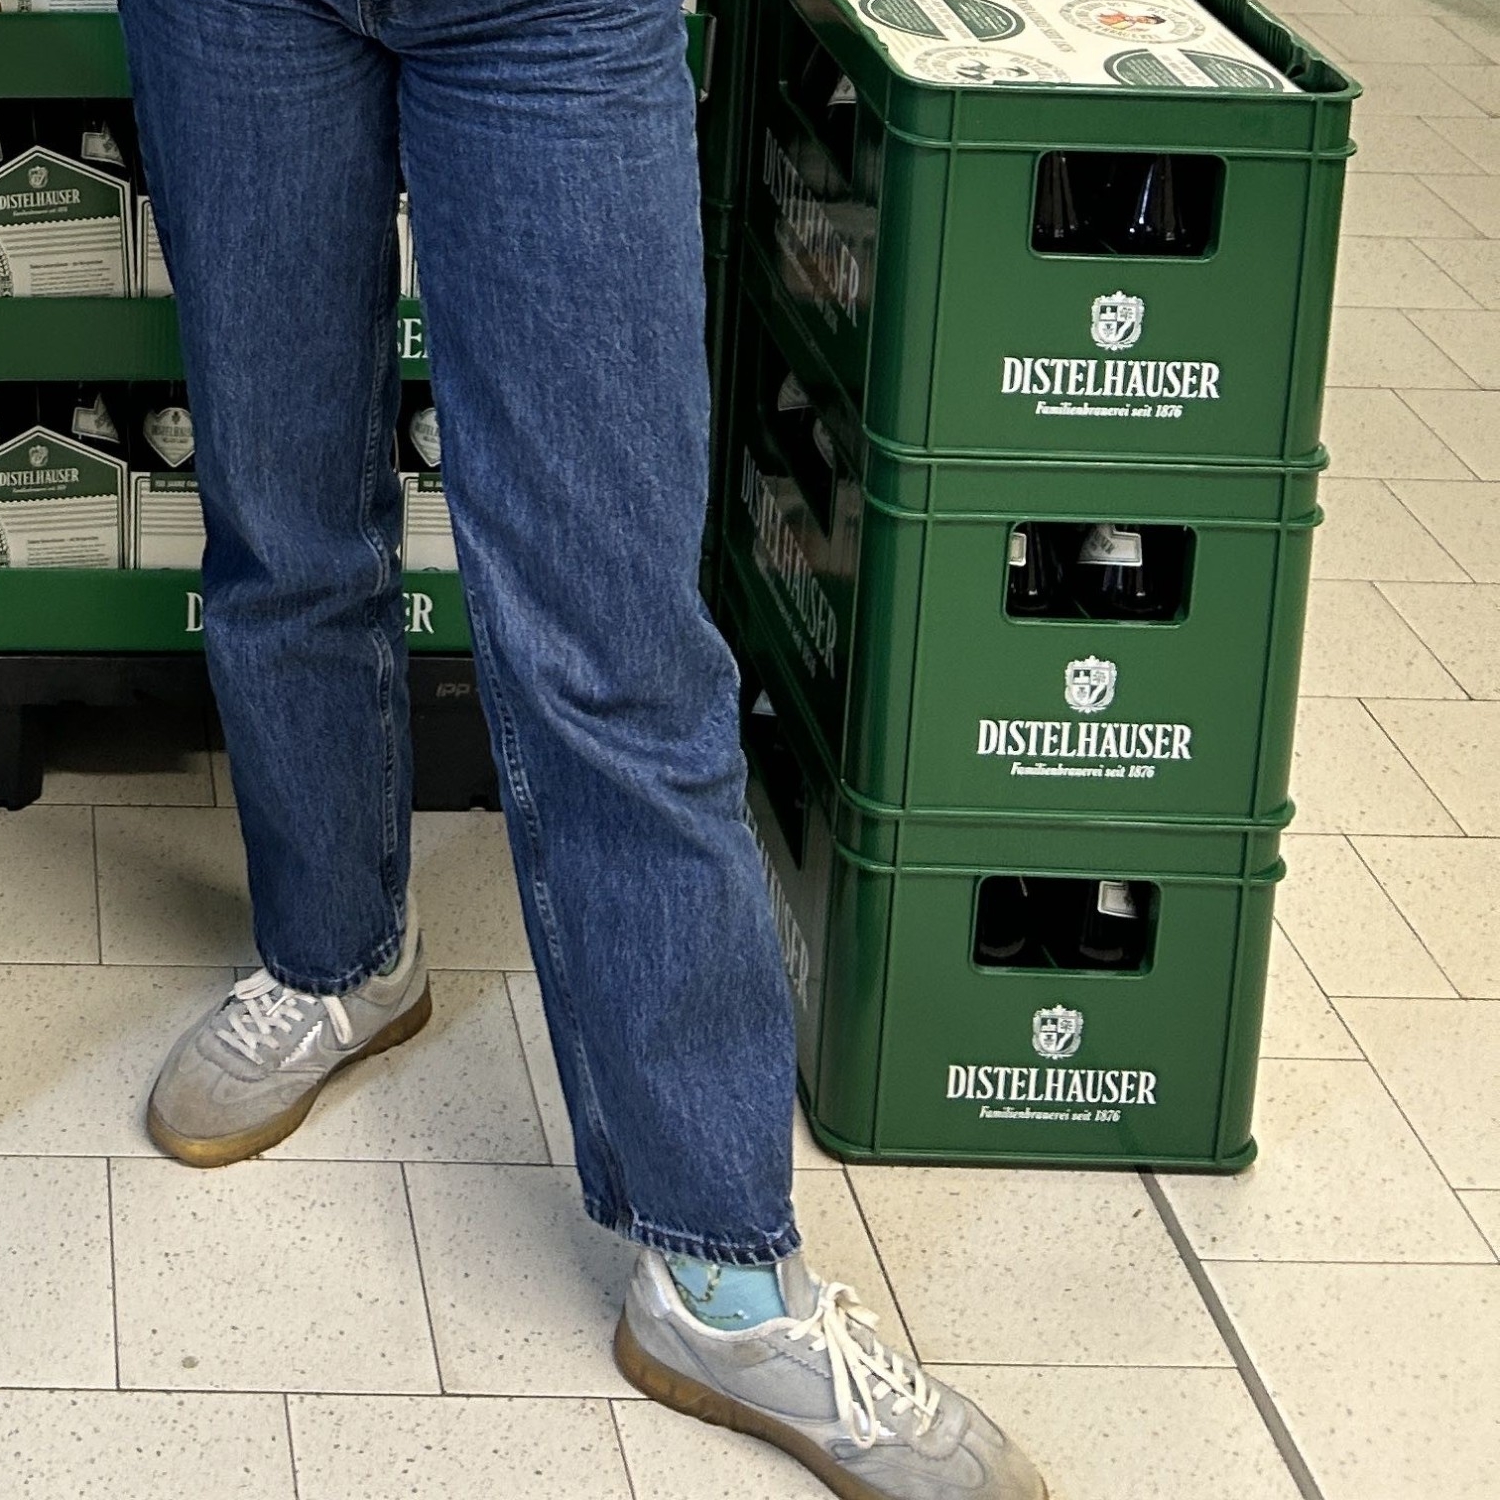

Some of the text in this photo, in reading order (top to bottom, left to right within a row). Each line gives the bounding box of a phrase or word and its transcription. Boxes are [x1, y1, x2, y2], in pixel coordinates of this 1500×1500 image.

[1001, 357, 1220, 399] DISTELHÄUSER
[1035, 401, 1183, 418] Familienbrauerei seit 1876
[977, 719, 1192, 759] DISTELHÄUSER
[946, 1065, 1157, 1105] DISTELHÄUSER
[979, 1106, 1121, 1122] Familienbrauerei seit 1876
